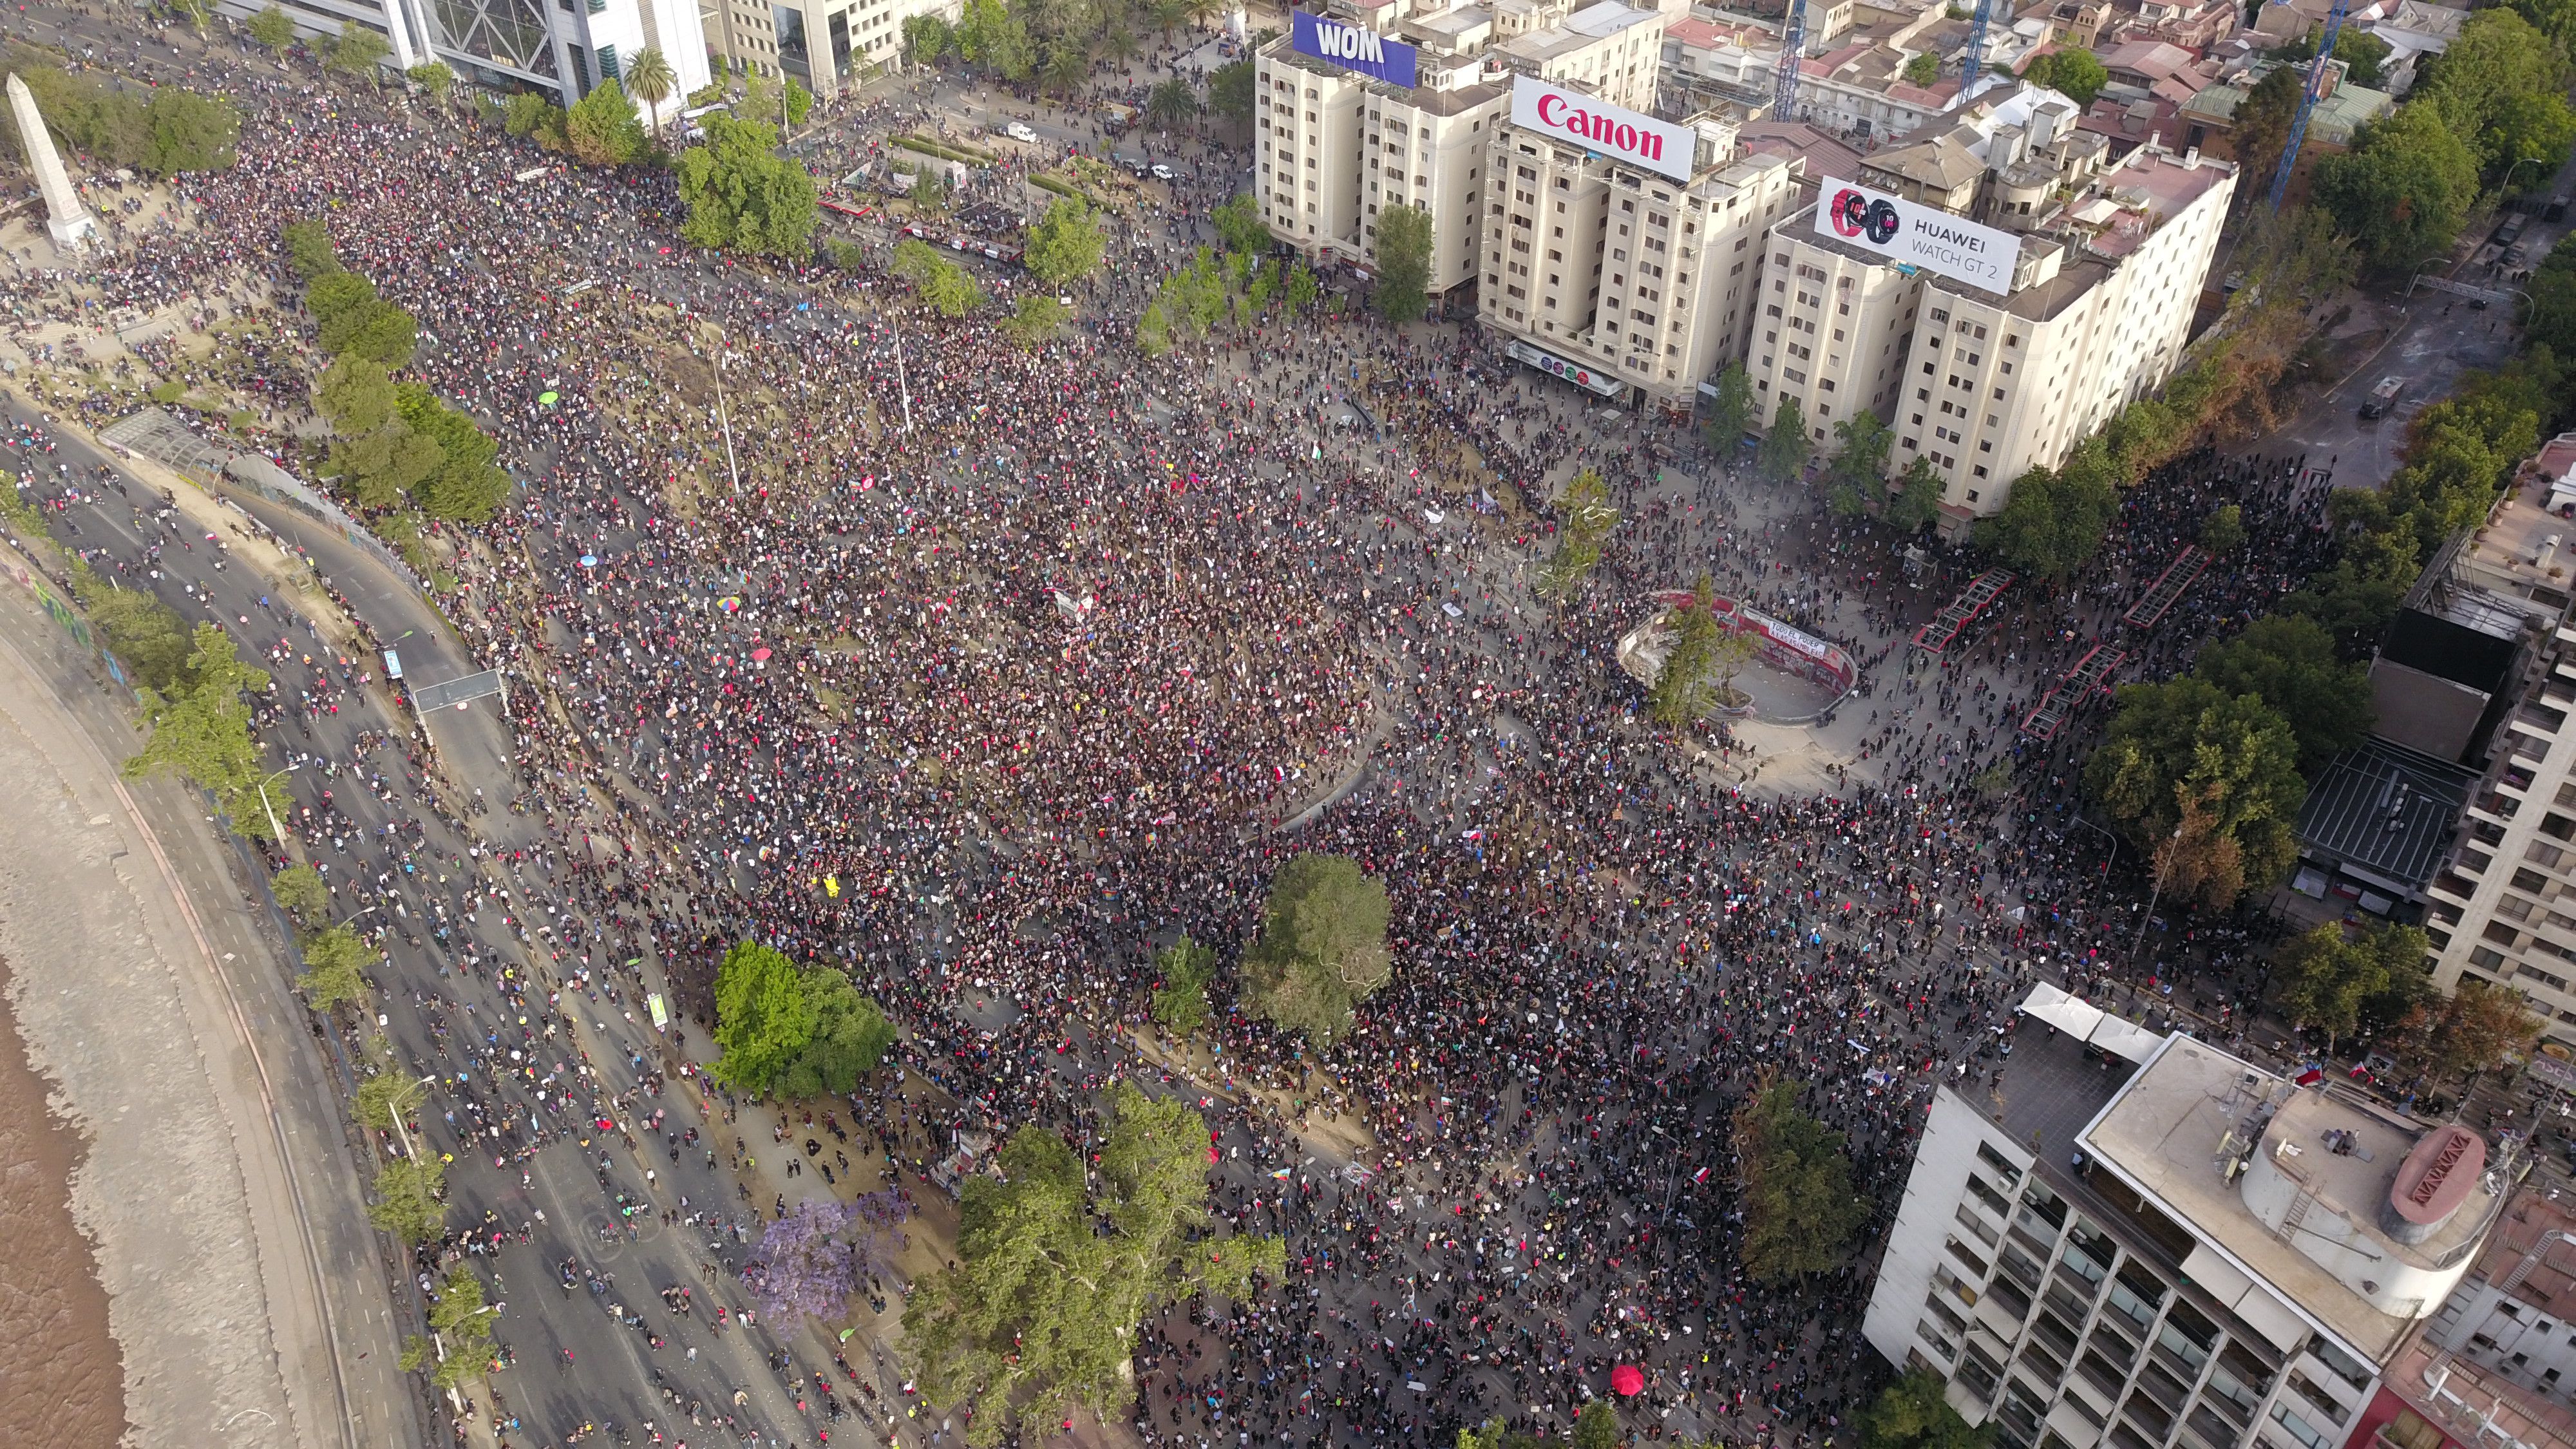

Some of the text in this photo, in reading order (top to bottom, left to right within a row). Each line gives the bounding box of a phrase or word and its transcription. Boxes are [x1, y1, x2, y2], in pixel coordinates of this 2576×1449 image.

[1316, 23, 1385, 63] WOM
[1537, 94, 1663, 161] Canon
[1915, 219, 1985, 254] HUAWEI
[1912, 238, 1998, 279] WATCH GT 2
[1772, 623, 1819, 649] TODO EL PODER
[1776, 632, 1788, 643] LAS
[1789, 639, 1823, 658] ASAMBLEAS
